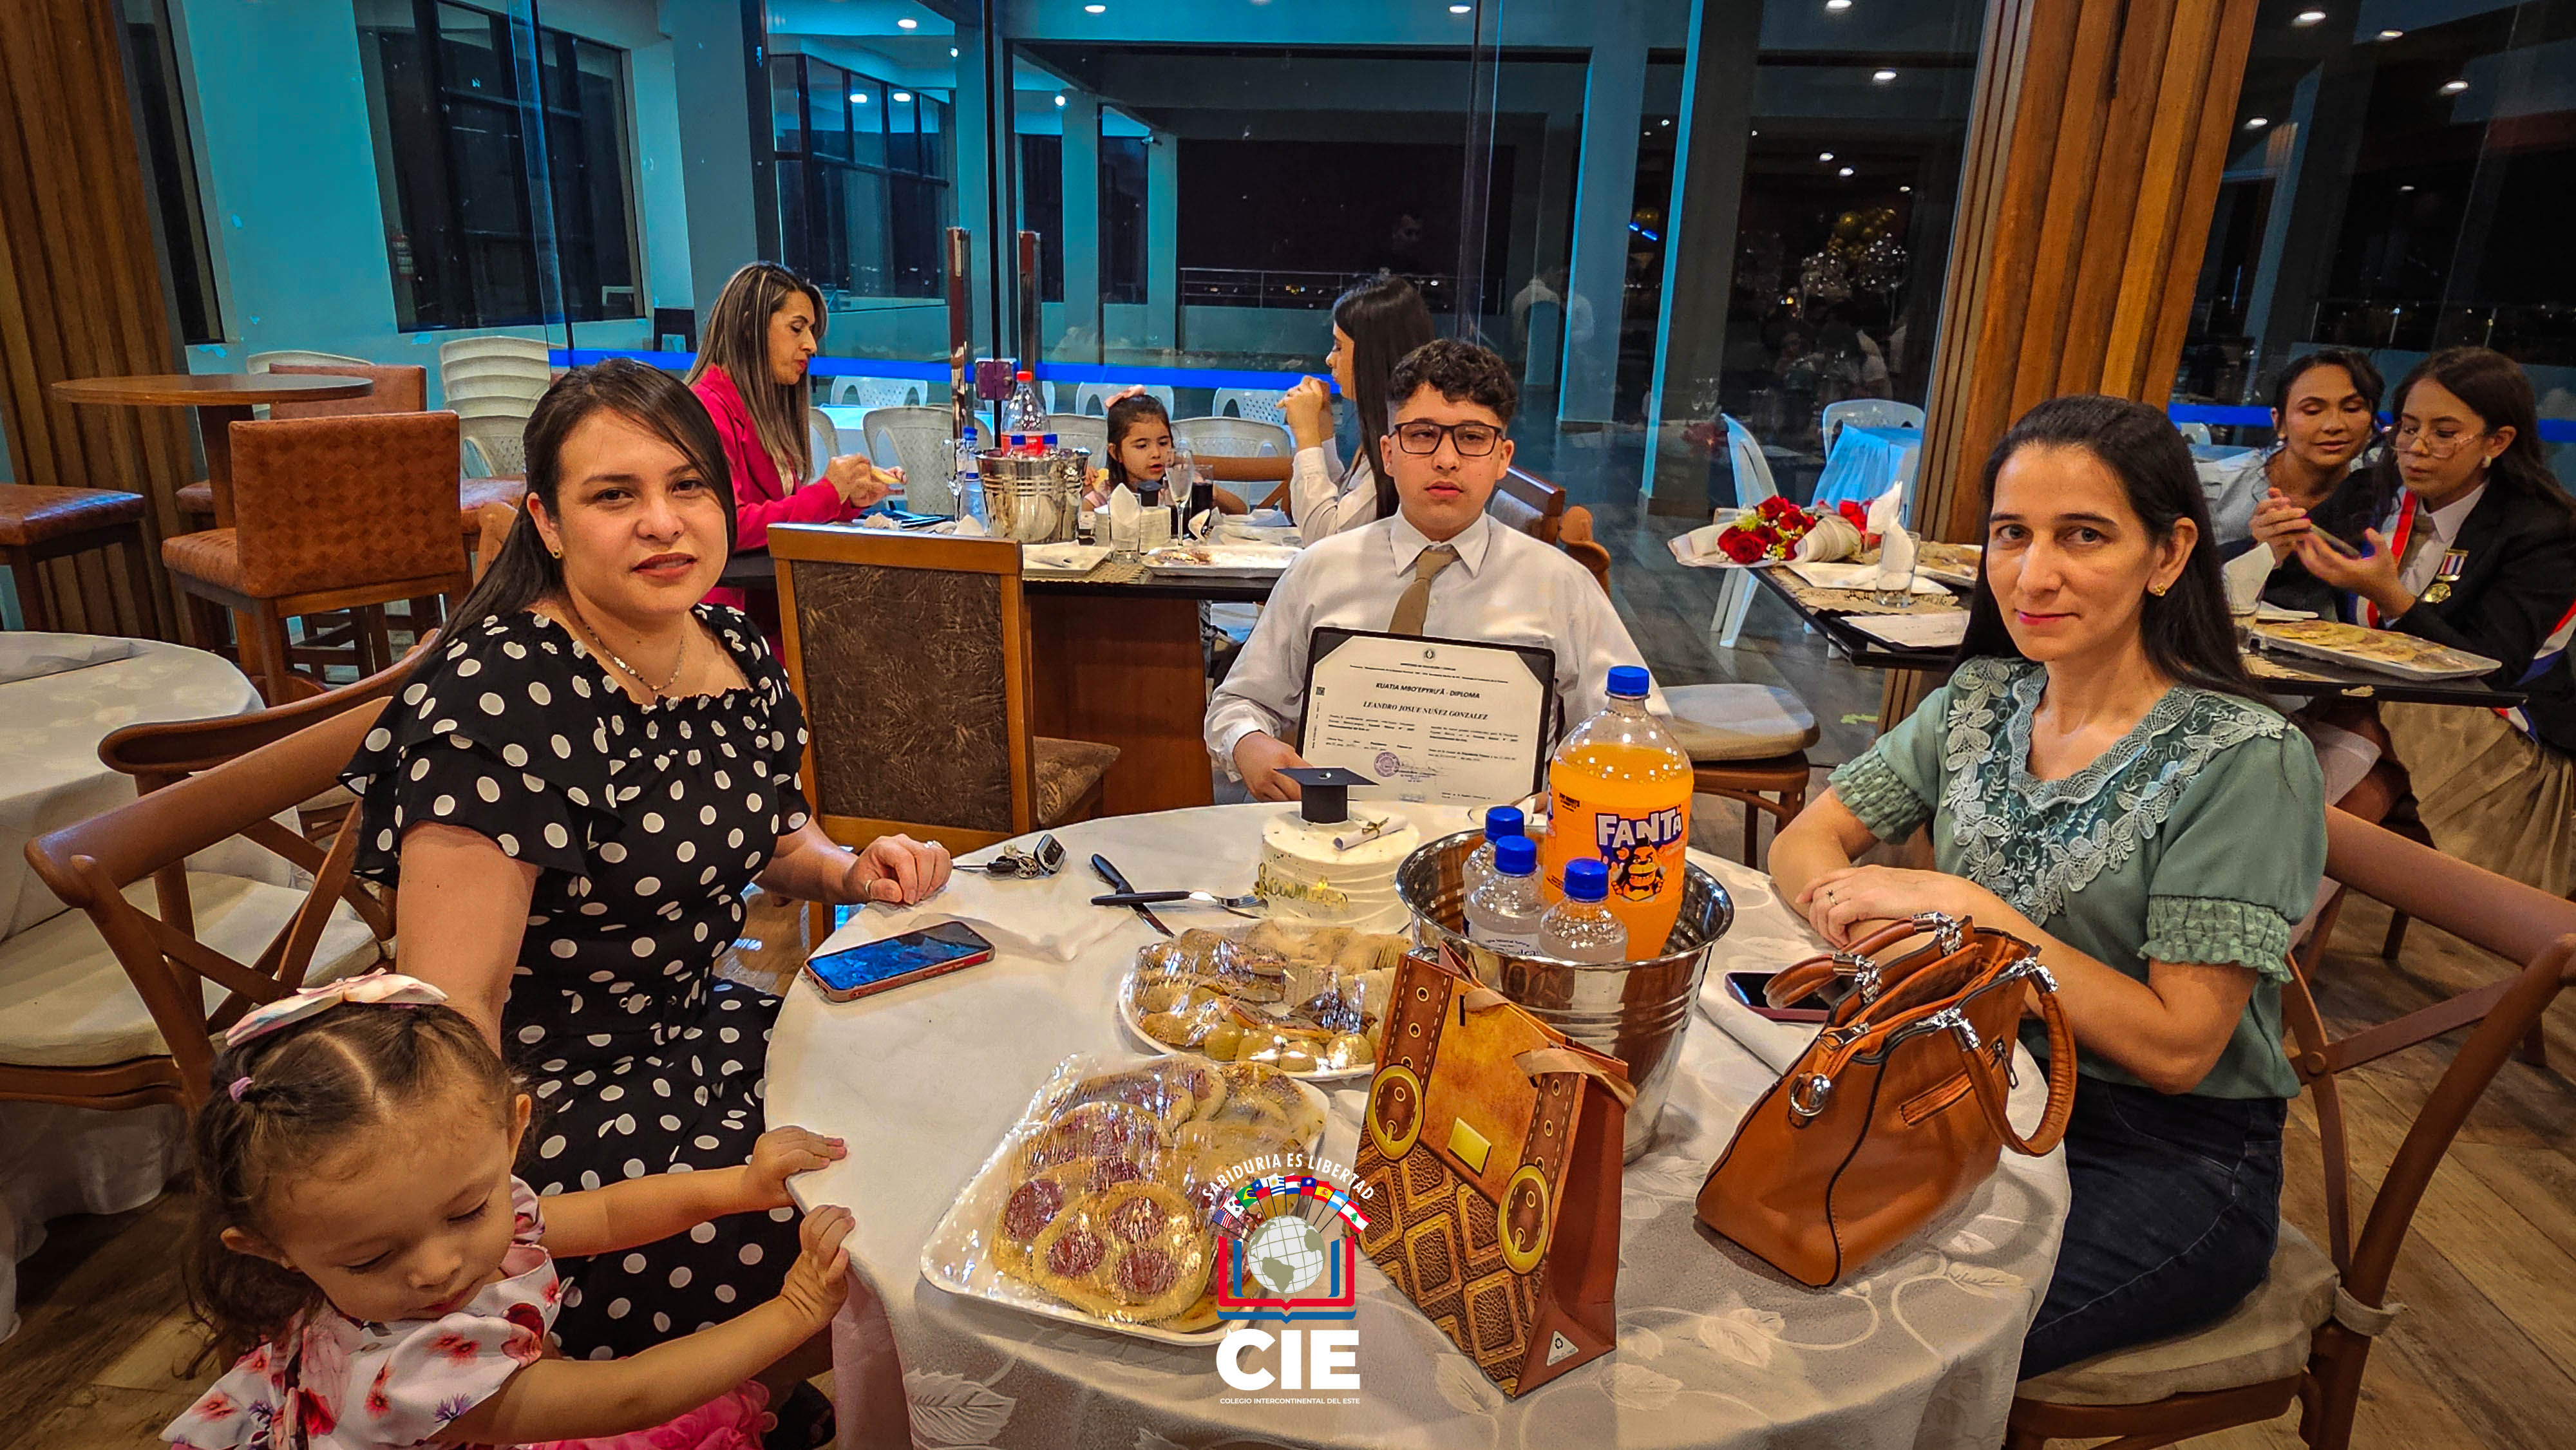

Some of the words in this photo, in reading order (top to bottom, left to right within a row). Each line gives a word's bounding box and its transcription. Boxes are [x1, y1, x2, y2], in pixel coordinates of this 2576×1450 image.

[1450, 690, 1480, 699] DIPLOMA
[1363, 701, 1397, 710] LEANDRO
[1449, 711, 1488, 720] GONZALEZ
[1597, 808, 1682, 848] FANTA
